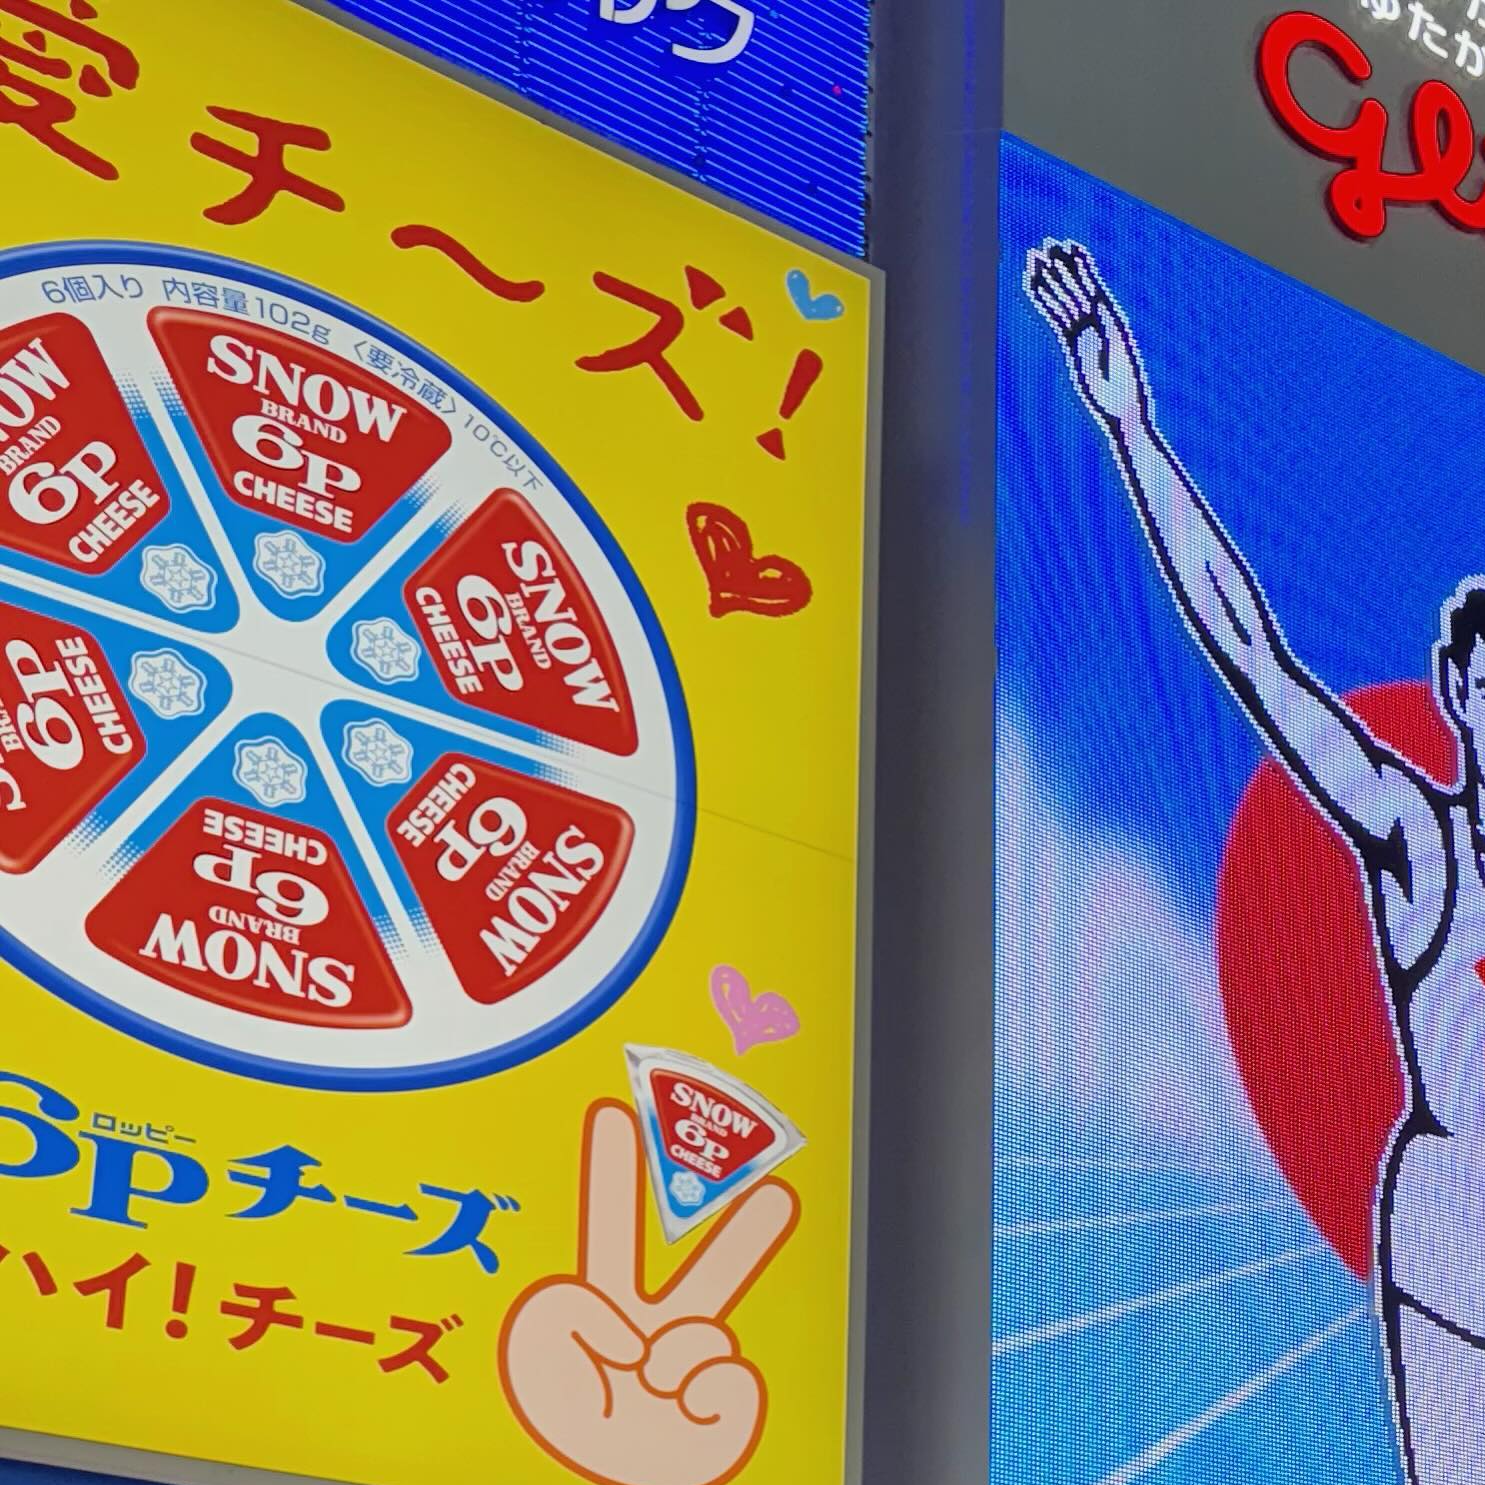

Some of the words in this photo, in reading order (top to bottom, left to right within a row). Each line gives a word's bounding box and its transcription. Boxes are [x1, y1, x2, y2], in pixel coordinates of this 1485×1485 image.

[41, 274, 144, 304] 6個入り
[0, 337, 70, 442] OW
[207, 335, 407, 443] SNOW
[260, 398, 347, 445] BRAND
[68, 479, 160, 563] CHEESE
[233, 471, 353, 534] CHEESE
[416, 587, 483, 694] CHEESE
[501, 540, 620, 712] SNOW
[505, 592, 552, 669] BRAND
[55, 636, 133, 754] CHEESE
[203, 808, 328, 866] CHEESE
[397, 763, 476, 848] CHEESE
[479, 824, 604, 977] SNOW
[485, 841, 540, 902] BRAND
[139, 912, 355, 1007] SNOW
[208, 905, 301, 945] BRAND
[92, 1112, 197, 1145] ロッピー
[670, 1082, 757, 1139] SNOW
[670, 1144, 723, 1178] CHEESE
